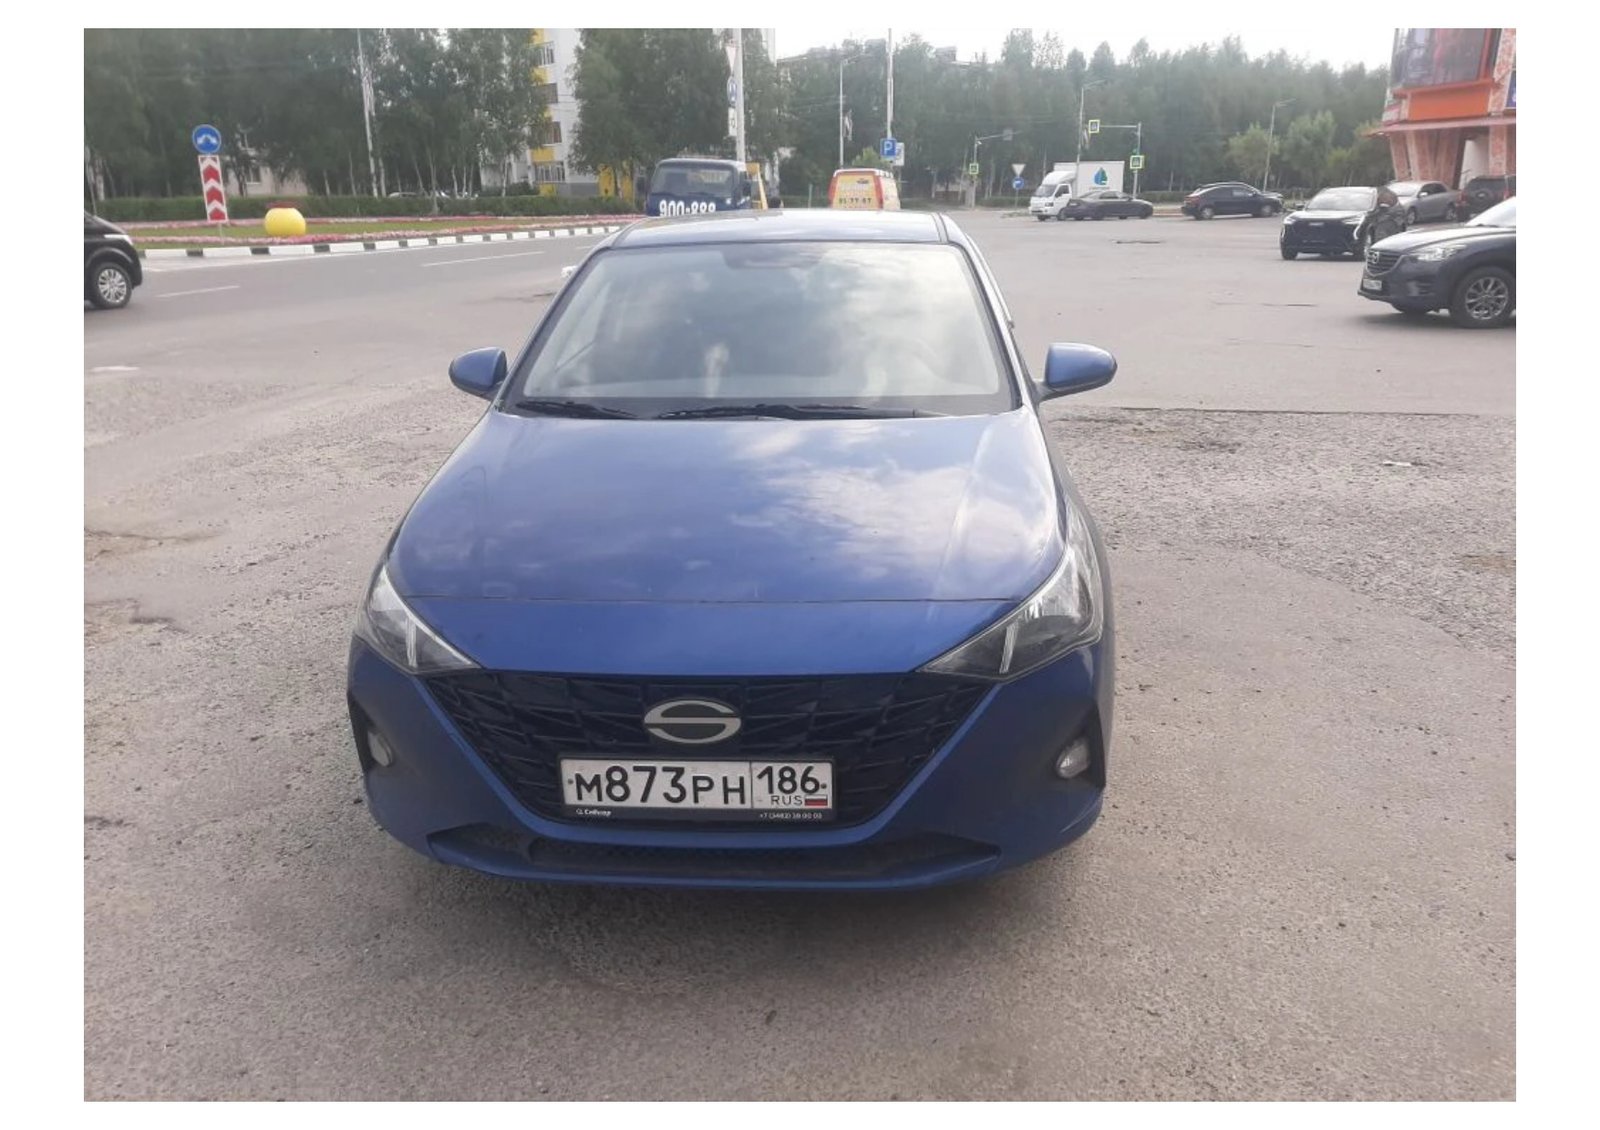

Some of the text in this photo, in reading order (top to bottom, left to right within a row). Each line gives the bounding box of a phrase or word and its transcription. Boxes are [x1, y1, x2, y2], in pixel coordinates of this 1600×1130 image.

[575, 765, 820, 805] М873РН 186
[770, 794, 803, 806] RUS
